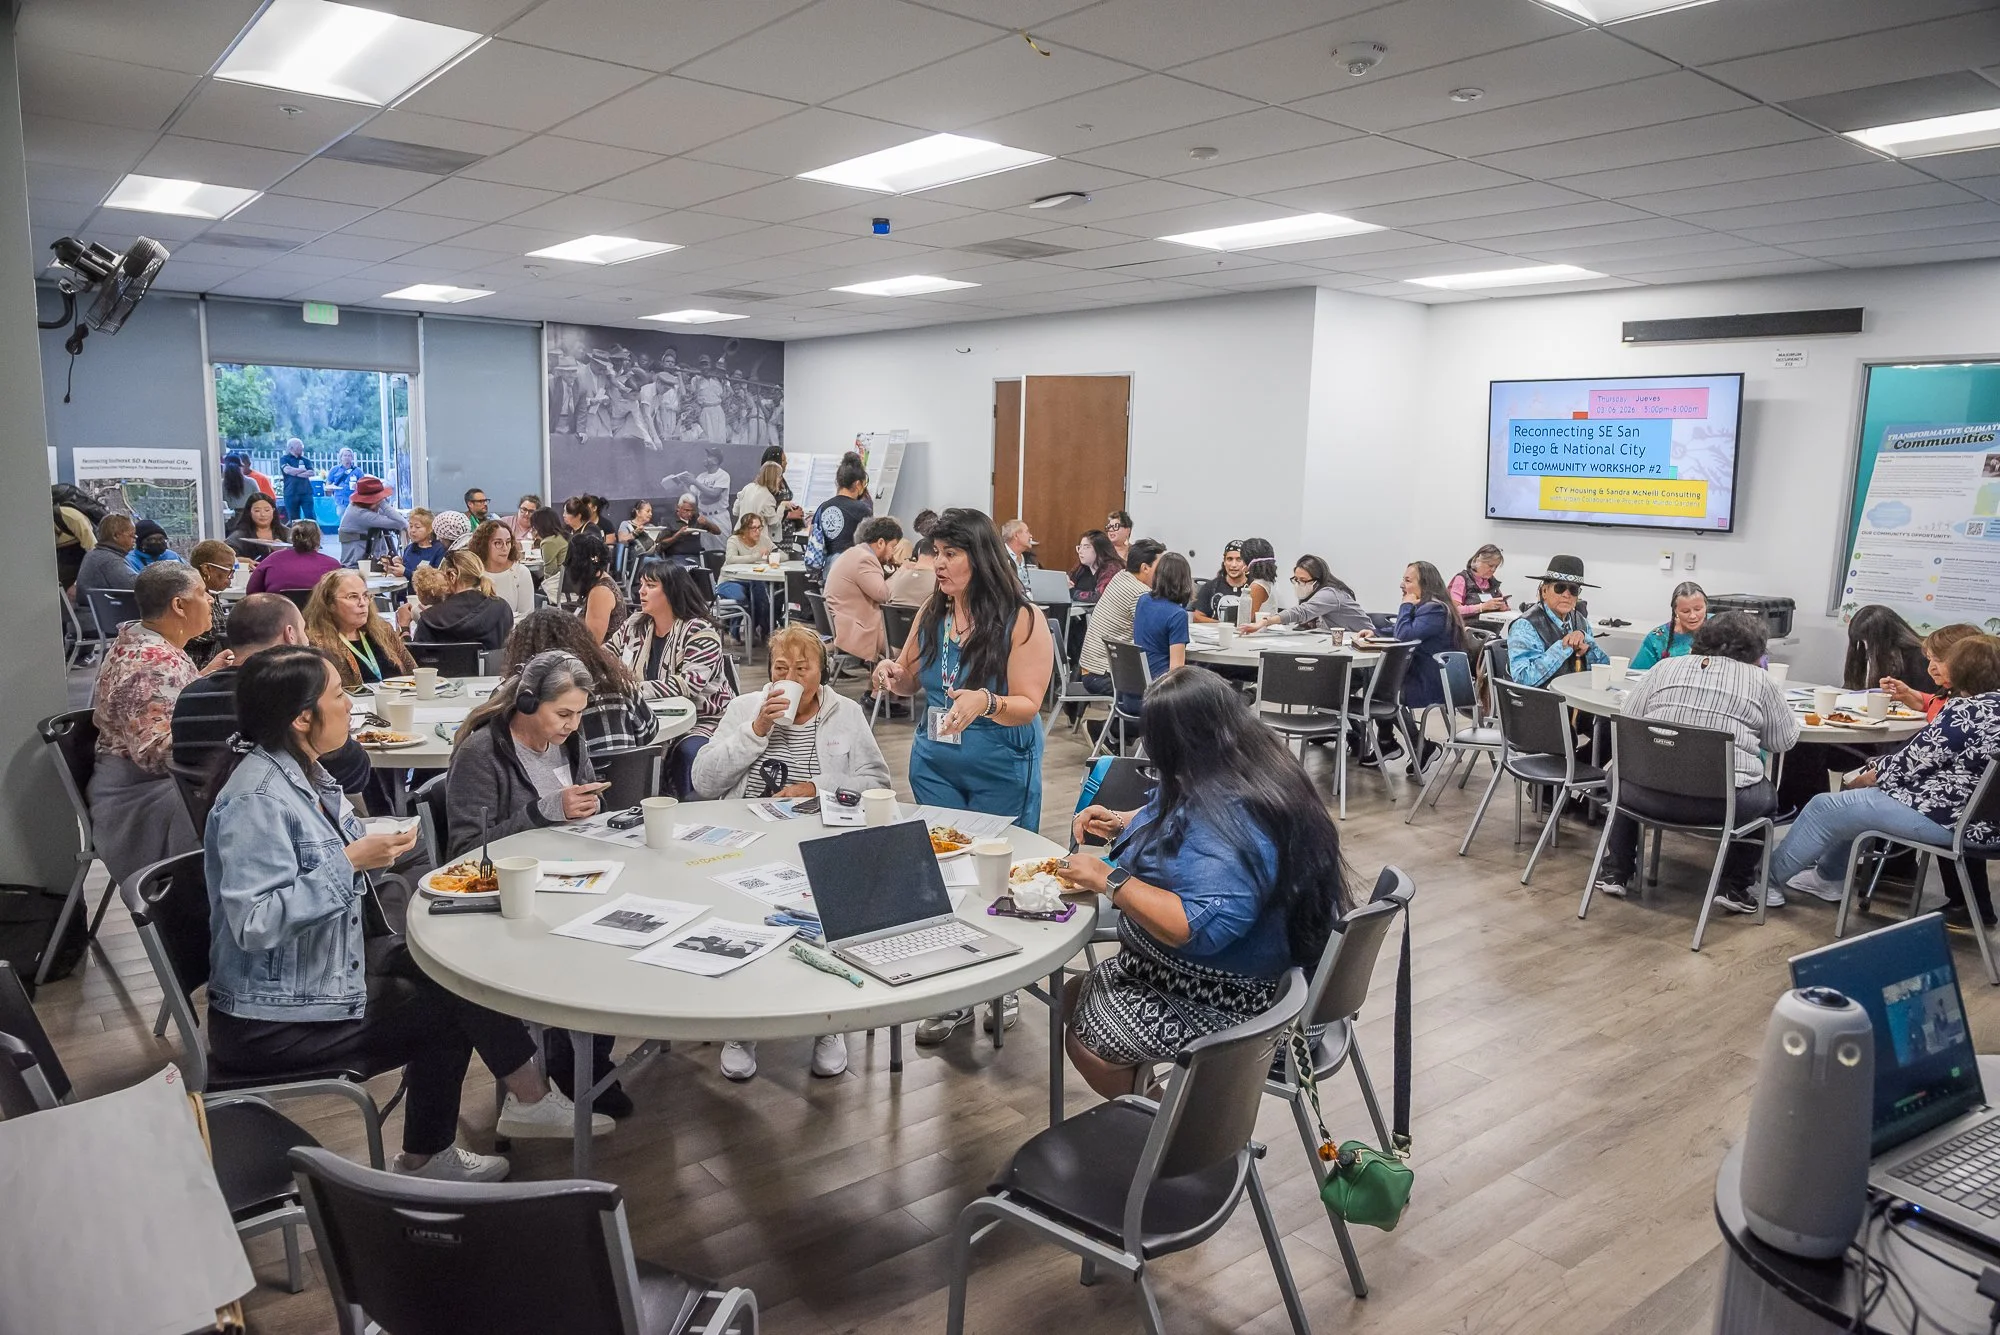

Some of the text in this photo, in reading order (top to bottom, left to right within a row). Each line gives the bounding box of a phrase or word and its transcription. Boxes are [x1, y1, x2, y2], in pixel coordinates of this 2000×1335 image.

[1597, 394, 1661, 403] Thursday Jueves
[1514, 425, 1640, 440] Reconnecting SE San
[1887, 427, 1963, 441] TRANSFORMATIVE
[1893, 432, 1995, 450] Communities
[1513, 442, 1646, 458] Diego & National City
[1512, 461, 1662, 474] CLT COMMUNITY WORKSHOP #2
[1569, 487, 1597, 495] Housing
[1661, 490, 1701, 500] Consulting
